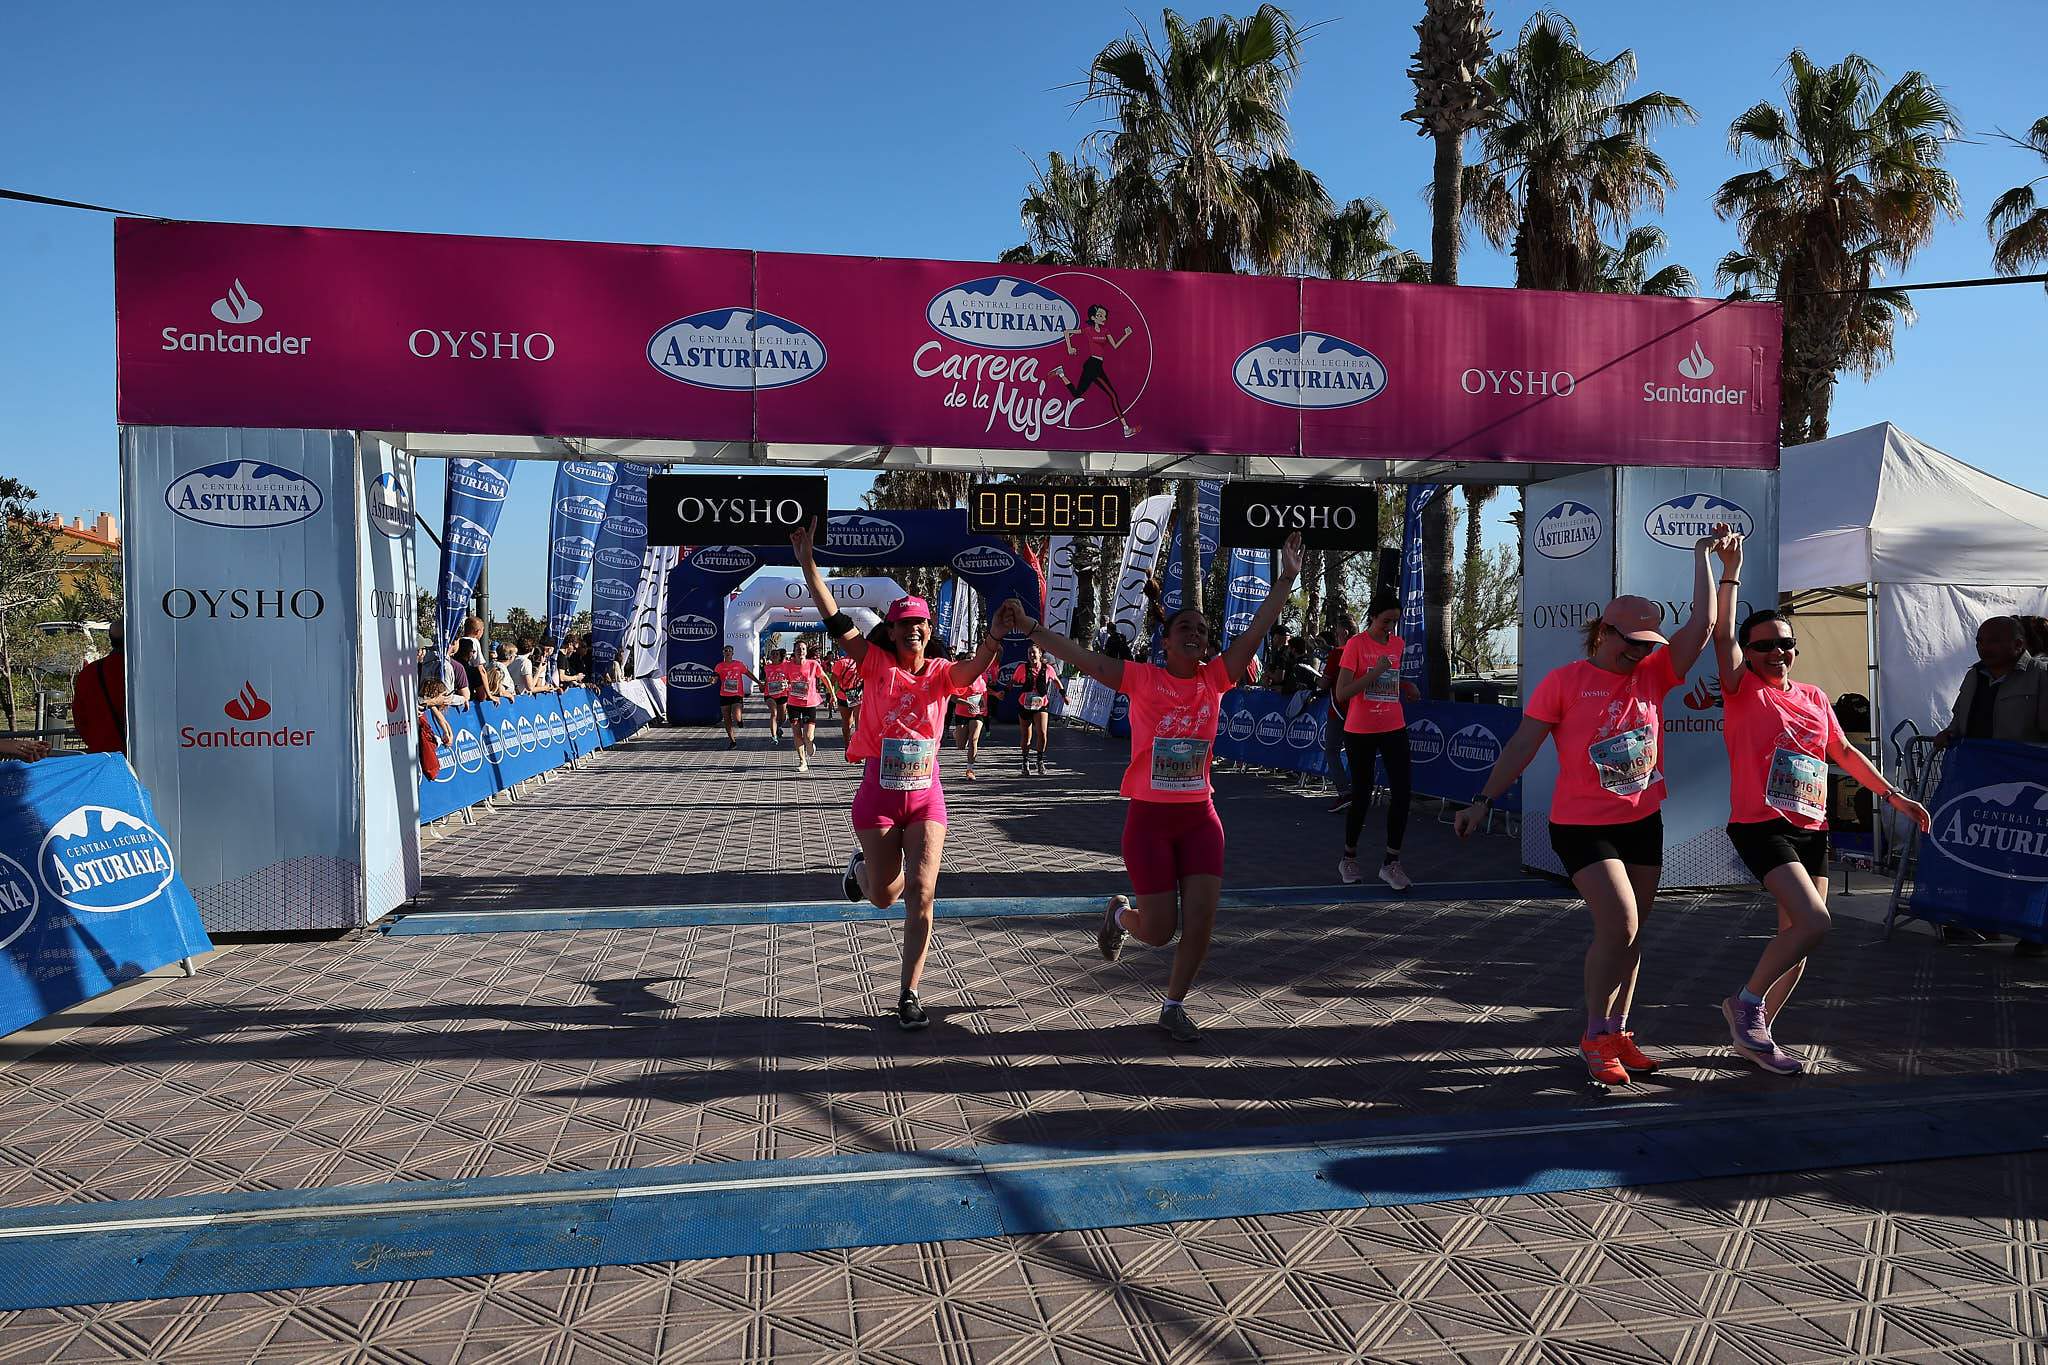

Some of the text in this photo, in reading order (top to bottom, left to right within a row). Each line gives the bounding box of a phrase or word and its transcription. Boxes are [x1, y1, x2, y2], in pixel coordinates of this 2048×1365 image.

[938, 300, 1066, 332] ASTURIANA
[962, 299, 1063, 312] CENTRAL LECHERA
[161, 327, 311, 355] Santander
[408, 329, 555, 361] OYSHO
[661, 335, 814, 369] ASTURIANA
[689, 335, 745, 345] CENTRAL
[912, 340, 1039, 383] Carrera
[1245, 358, 1376, 390] ASTURIANA
[1322, 359, 1371, 368] LECHERA
[1460, 368, 1577, 397] OYSHO
[1643, 382, 1748, 405] Santander
[943, 380, 1085, 442] de la Mujer
[177, 484, 312, 512] ASTURIANA
[201, 483, 307, 492] CENTRAL LECHERA
[676, 497, 804, 525] OYSHO
[980, 492, 1118, 527] 00:38:50
[1246, 503, 1356, 530] OYSHO
[1538, 525, 1597, 549] ASTURIANA
[1652, 514, 1746, 536] ASTURINA
[826, 534, 897, 547] STURIANA
[695, 553, 751, 566] ASTURIANA
[957, 556, 1011, 568] ASTURIANA
[162, 588, 325, 619] OYSHO
[370, 587, 412, 620] OYSHO
[1048, 546, 1075, 634] YSHO
[1533, 601, 1601, 629] OYSHO
[670, 625, 715, 635] ASTURIANA
[669, 672, 711, 683] ASTURIAN
[181, 726, 316, 749] Santander
[1450, 739, 1495, 762] ASTURIANA
[1973, 809, 2031, 825] CENTRAL
[1939, 808, 2048, 857] ASTURI
[66, 840, 112, 858] CENTRAL
